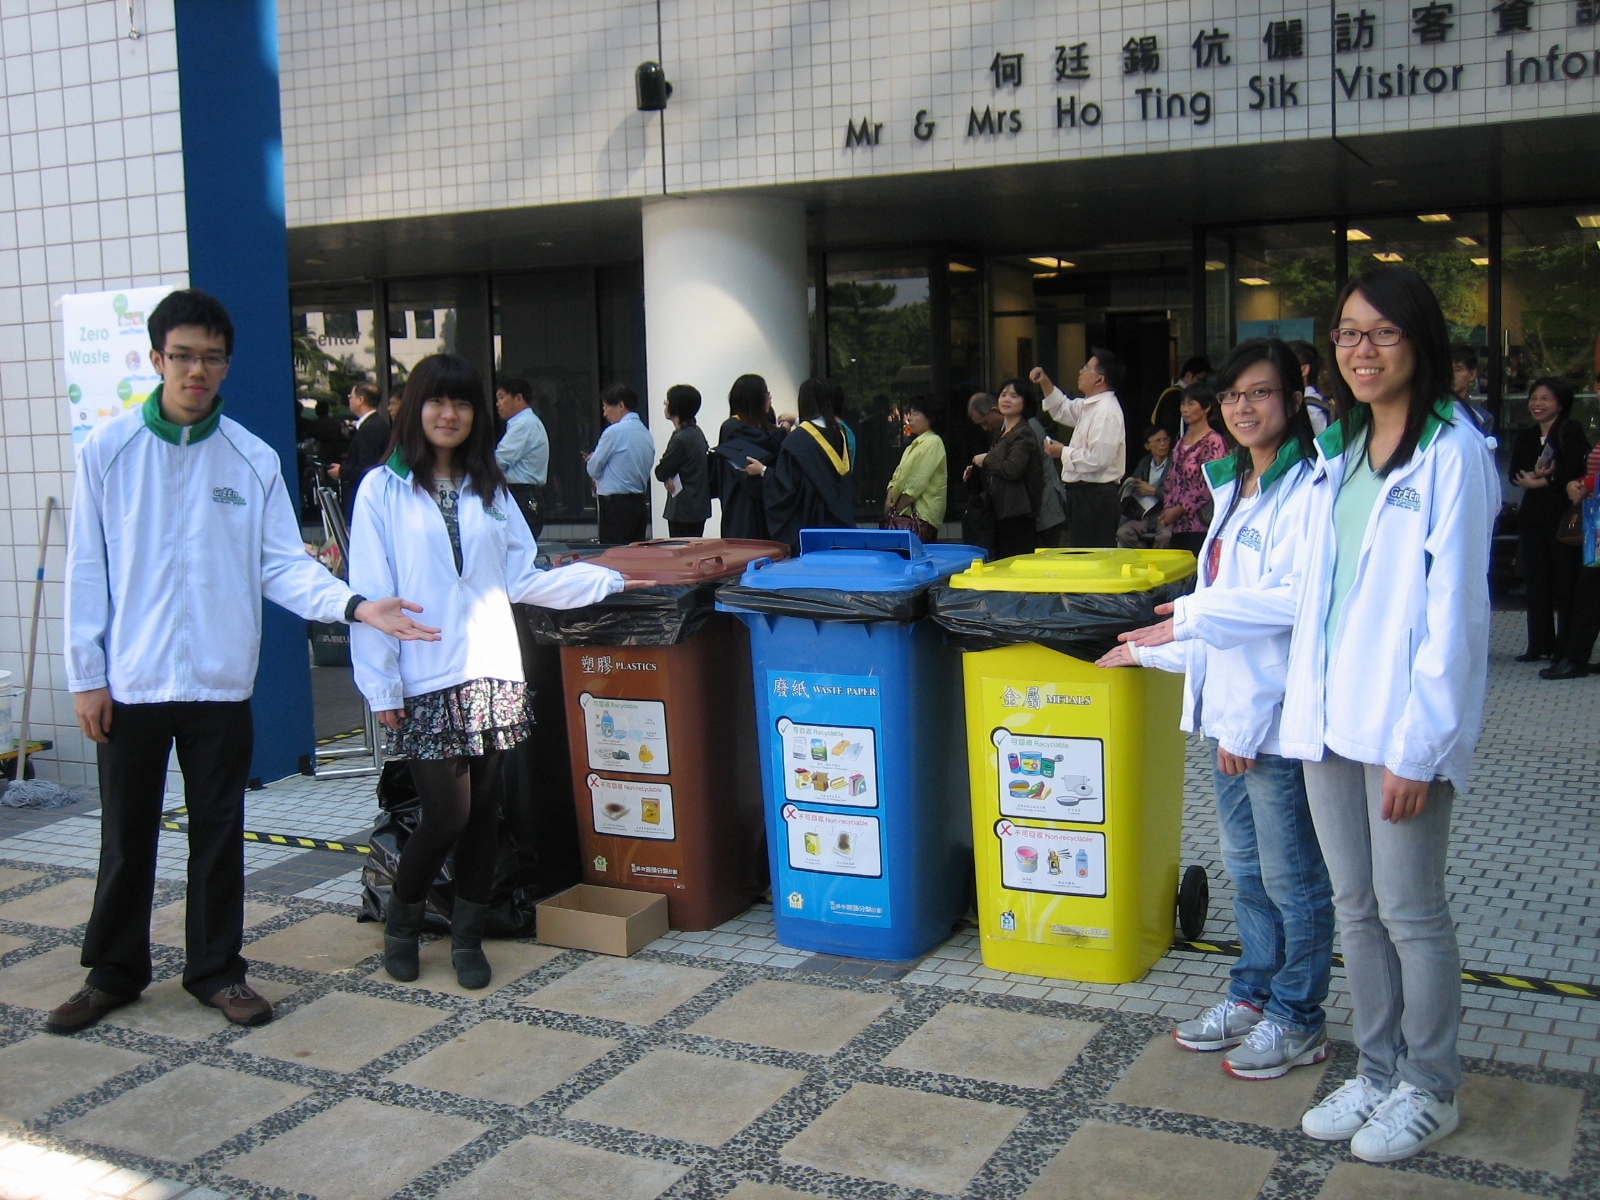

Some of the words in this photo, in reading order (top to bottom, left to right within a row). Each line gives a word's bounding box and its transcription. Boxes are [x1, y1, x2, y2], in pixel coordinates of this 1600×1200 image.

[845, 115, 883, 148] Mr
[913, 109, 936, 141] &
[967, 104, 1023, 137] Mrs
[1056, 95, 1102, 129] Ho
[1134, 87, 1212, 126] Ting
[1248, 73, 1299, 110] Sik
[1335, 63, 1464, 100] Visitor
[79, 327, 109, 341] Zero
[69, 350, 110, 365] Waste
[615, 661, 658, 671] PLASTICS
[812, 685, 844, 695] WASTE
[846, 687, 877, 697] PAPER
[999, 686, 1041, 710] 金屬
[1046, 694, 1092, 705] METALS
[813, 729, 845, 737] Recyclable
[1034, 740, 1069, 749] Recyclable
[825, 817, 868, 826] Non-recyclable
[1045, 833, 1094, 843] Non-recyclable
